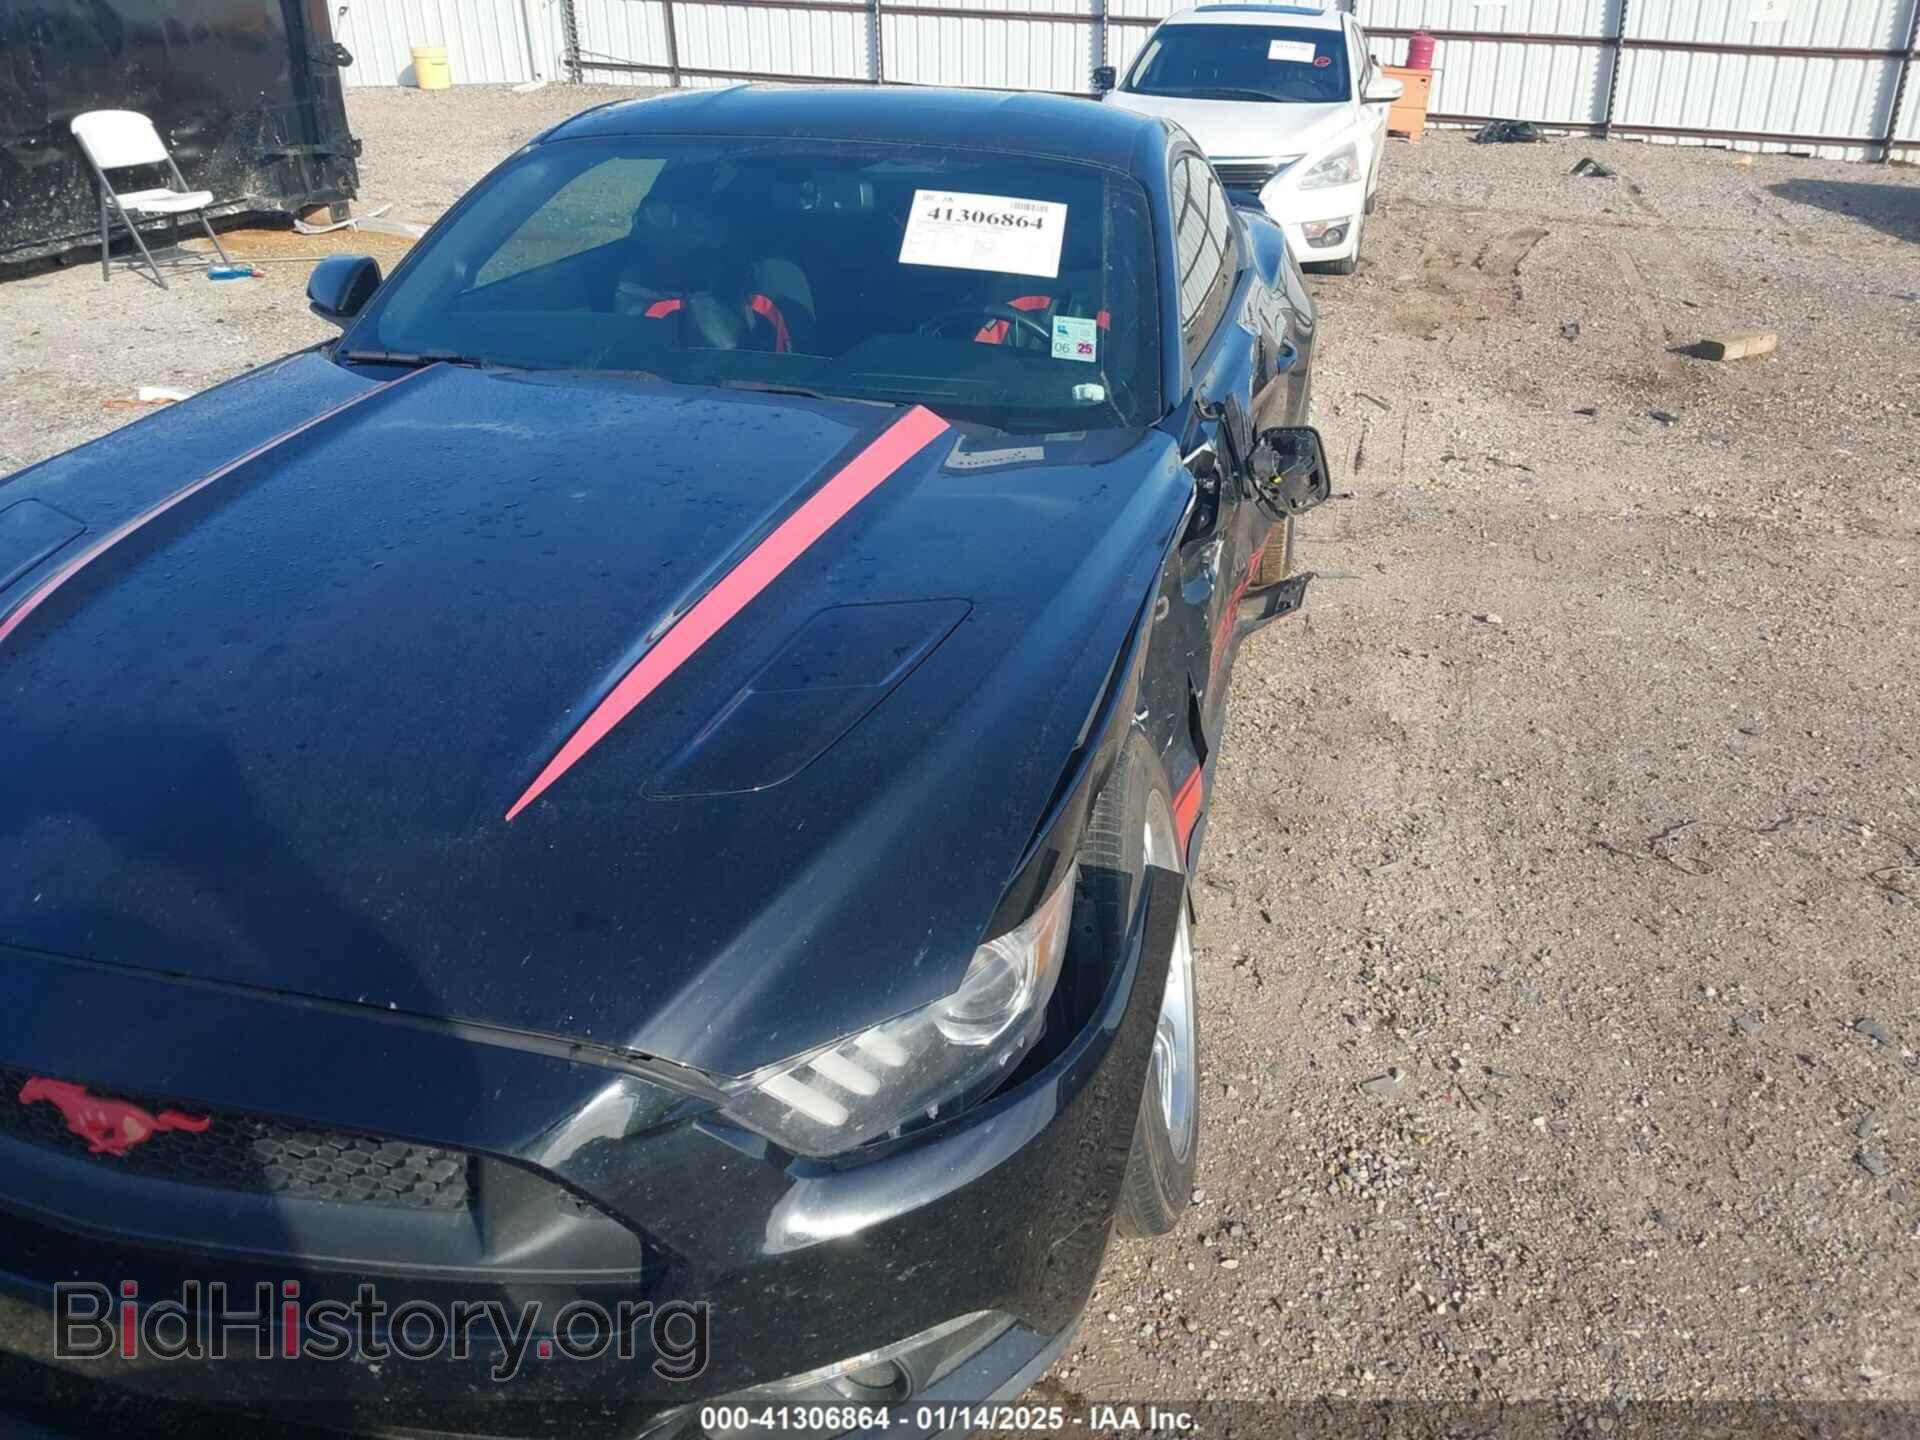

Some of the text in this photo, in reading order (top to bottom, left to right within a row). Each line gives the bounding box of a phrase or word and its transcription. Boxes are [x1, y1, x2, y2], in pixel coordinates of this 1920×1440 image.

[927, 206, 1044, 230] 41306864
[1054, 342, 1093, 354] 06 25
